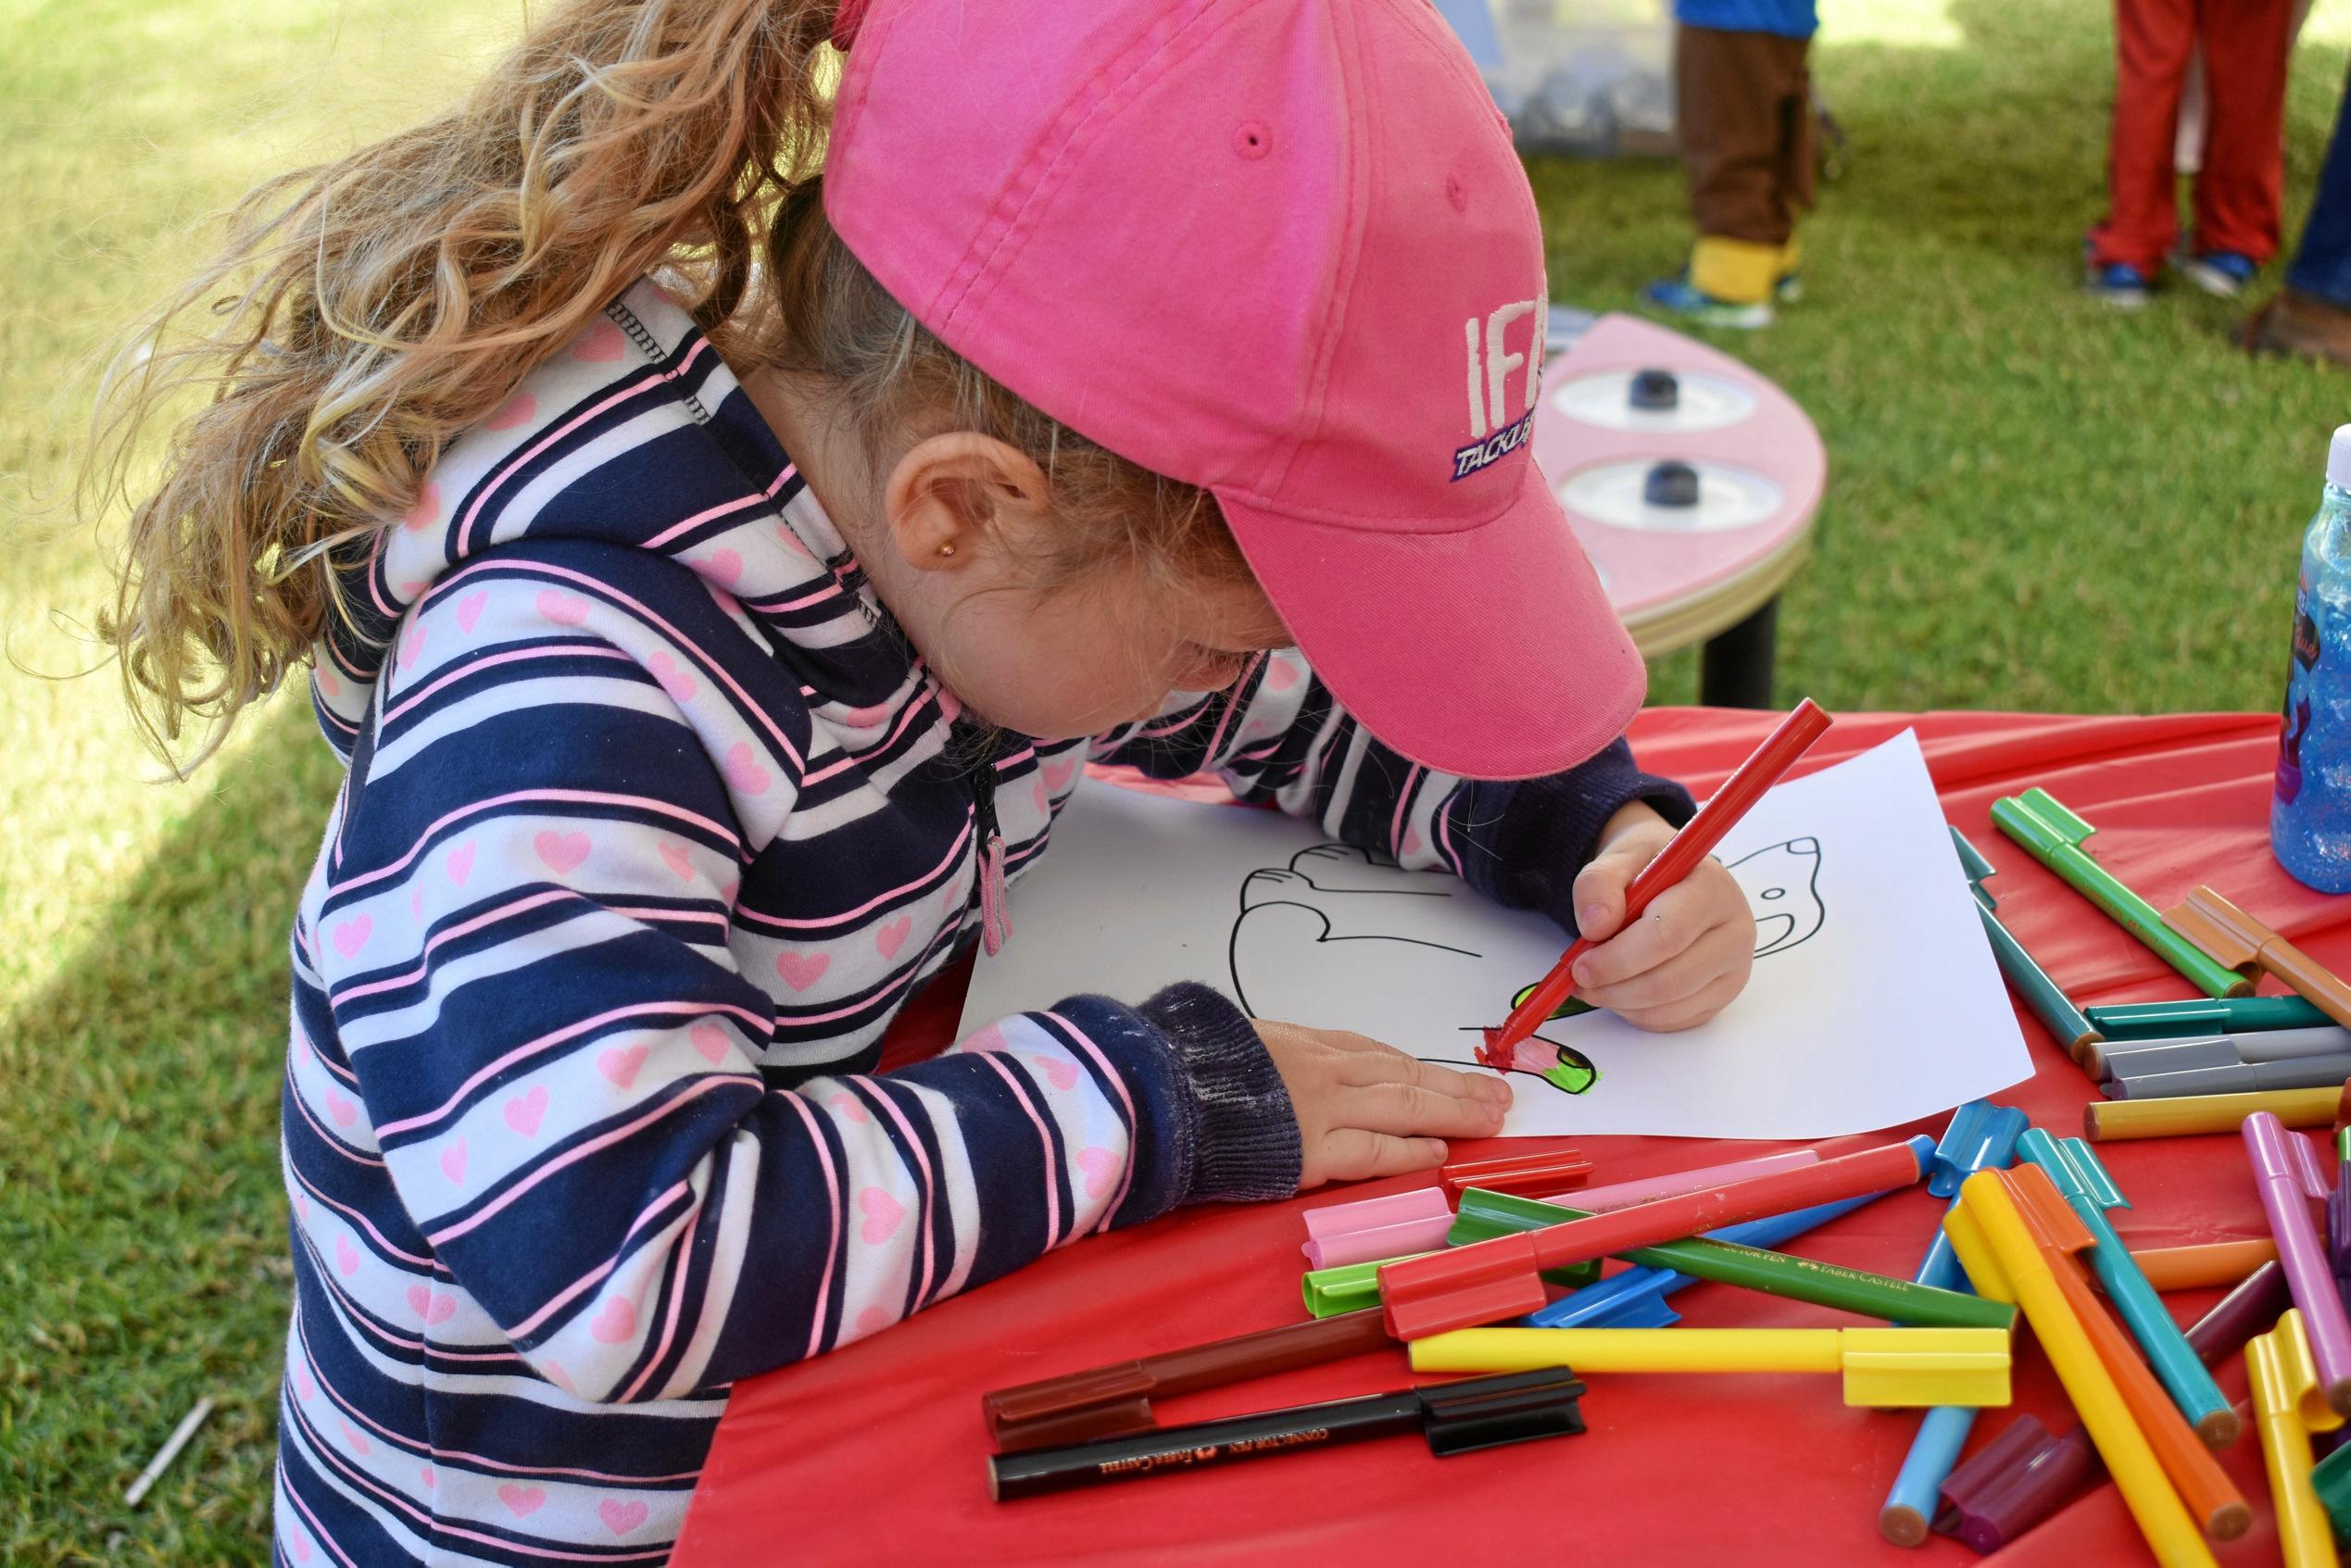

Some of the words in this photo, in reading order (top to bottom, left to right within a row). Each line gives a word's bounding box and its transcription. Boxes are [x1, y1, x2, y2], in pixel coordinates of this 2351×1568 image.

[1819, 1265, 1856, 1281] FABER
[1859, 1273, 1908, 1292] CASTELL
[1229, 1439, 1253, 1454] PEN
[1255, 1428, 1328, 1449] CONNECTOR
[1099, 1455, 1154, 1474] CASTELL
[1154, 1449, 1193, 1464] FABER
